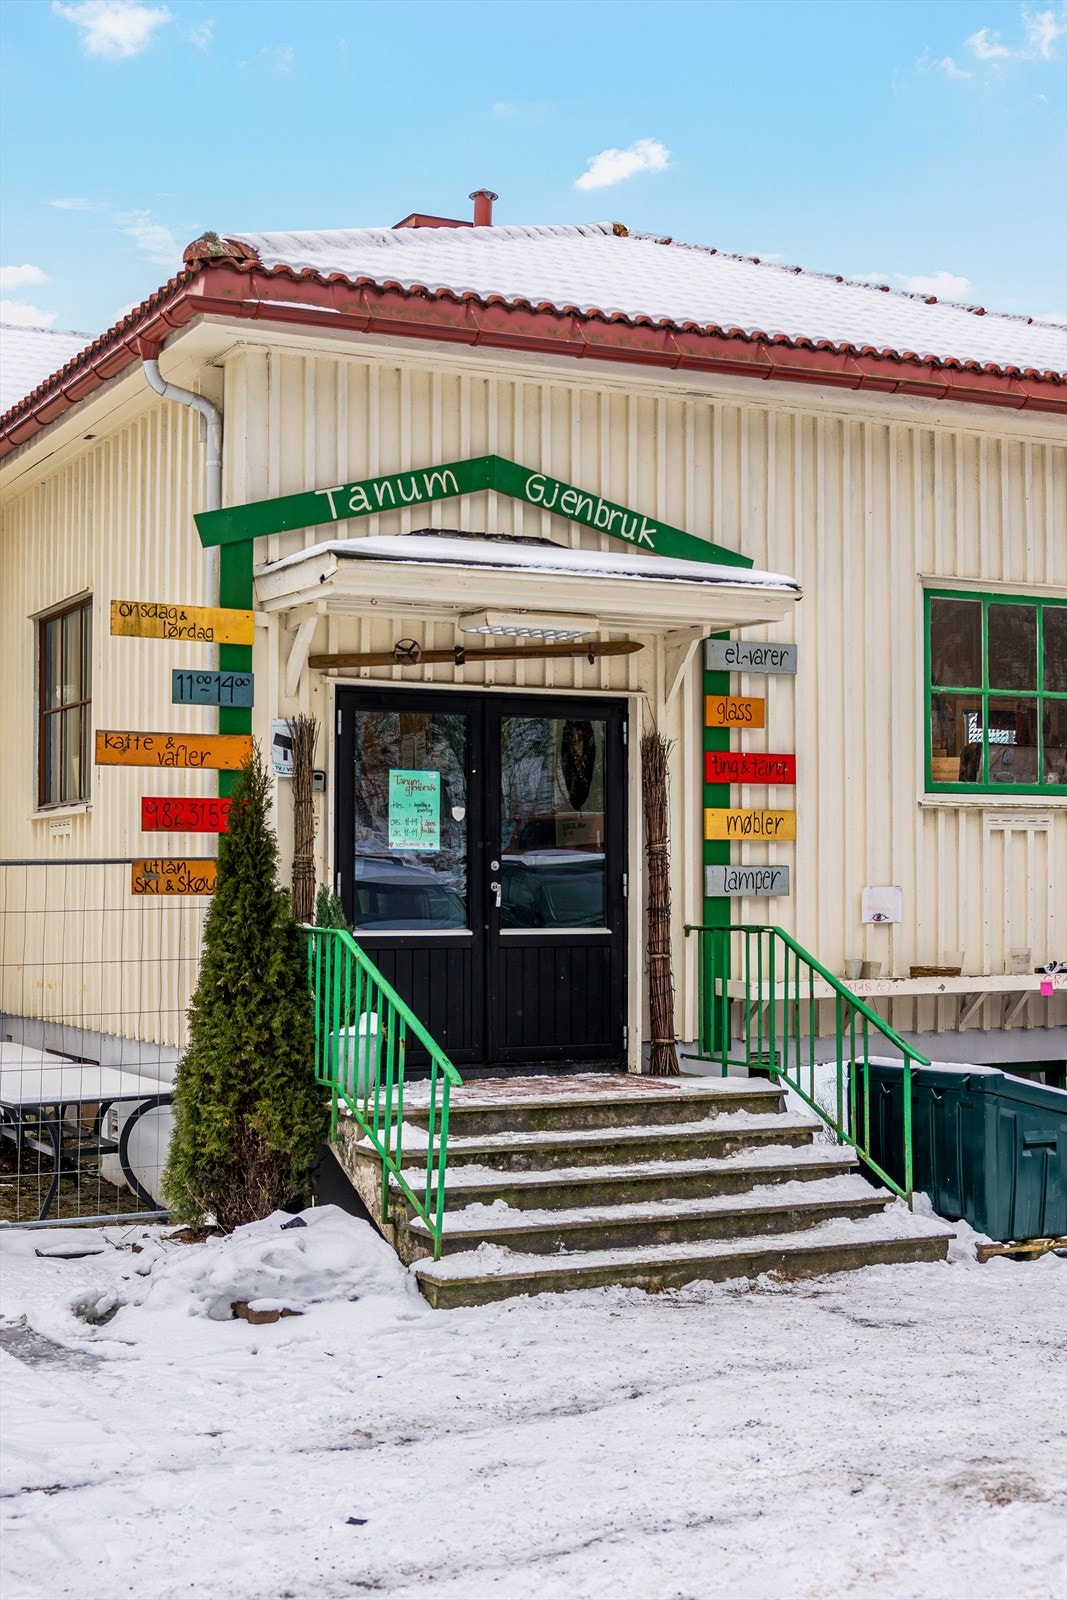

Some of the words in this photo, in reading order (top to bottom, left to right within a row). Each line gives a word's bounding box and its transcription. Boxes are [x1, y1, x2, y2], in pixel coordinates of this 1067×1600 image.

[314, 470, 460, 520] Tanum
[525, 473, 657, 549] Gjenbruk
[119, 603, 178, 626] onsdag
[179, 611, 188, 621] &
[163, 620, 215, 642] lørdag
[716, 697, 753, 725] glass
[165, 736, 176, 749] &
[157, 745, 212, 767] vafler
[712, 754, 739, 783] ting
[740, 762, 750, 775] &
[752, 757, 788, 784] tang
[726, 811, 784, 836] møbler
[143, 859, 187, 875] utlån
[165, 879, 175, 892] &
[723, 867, 781, 896] lamper
